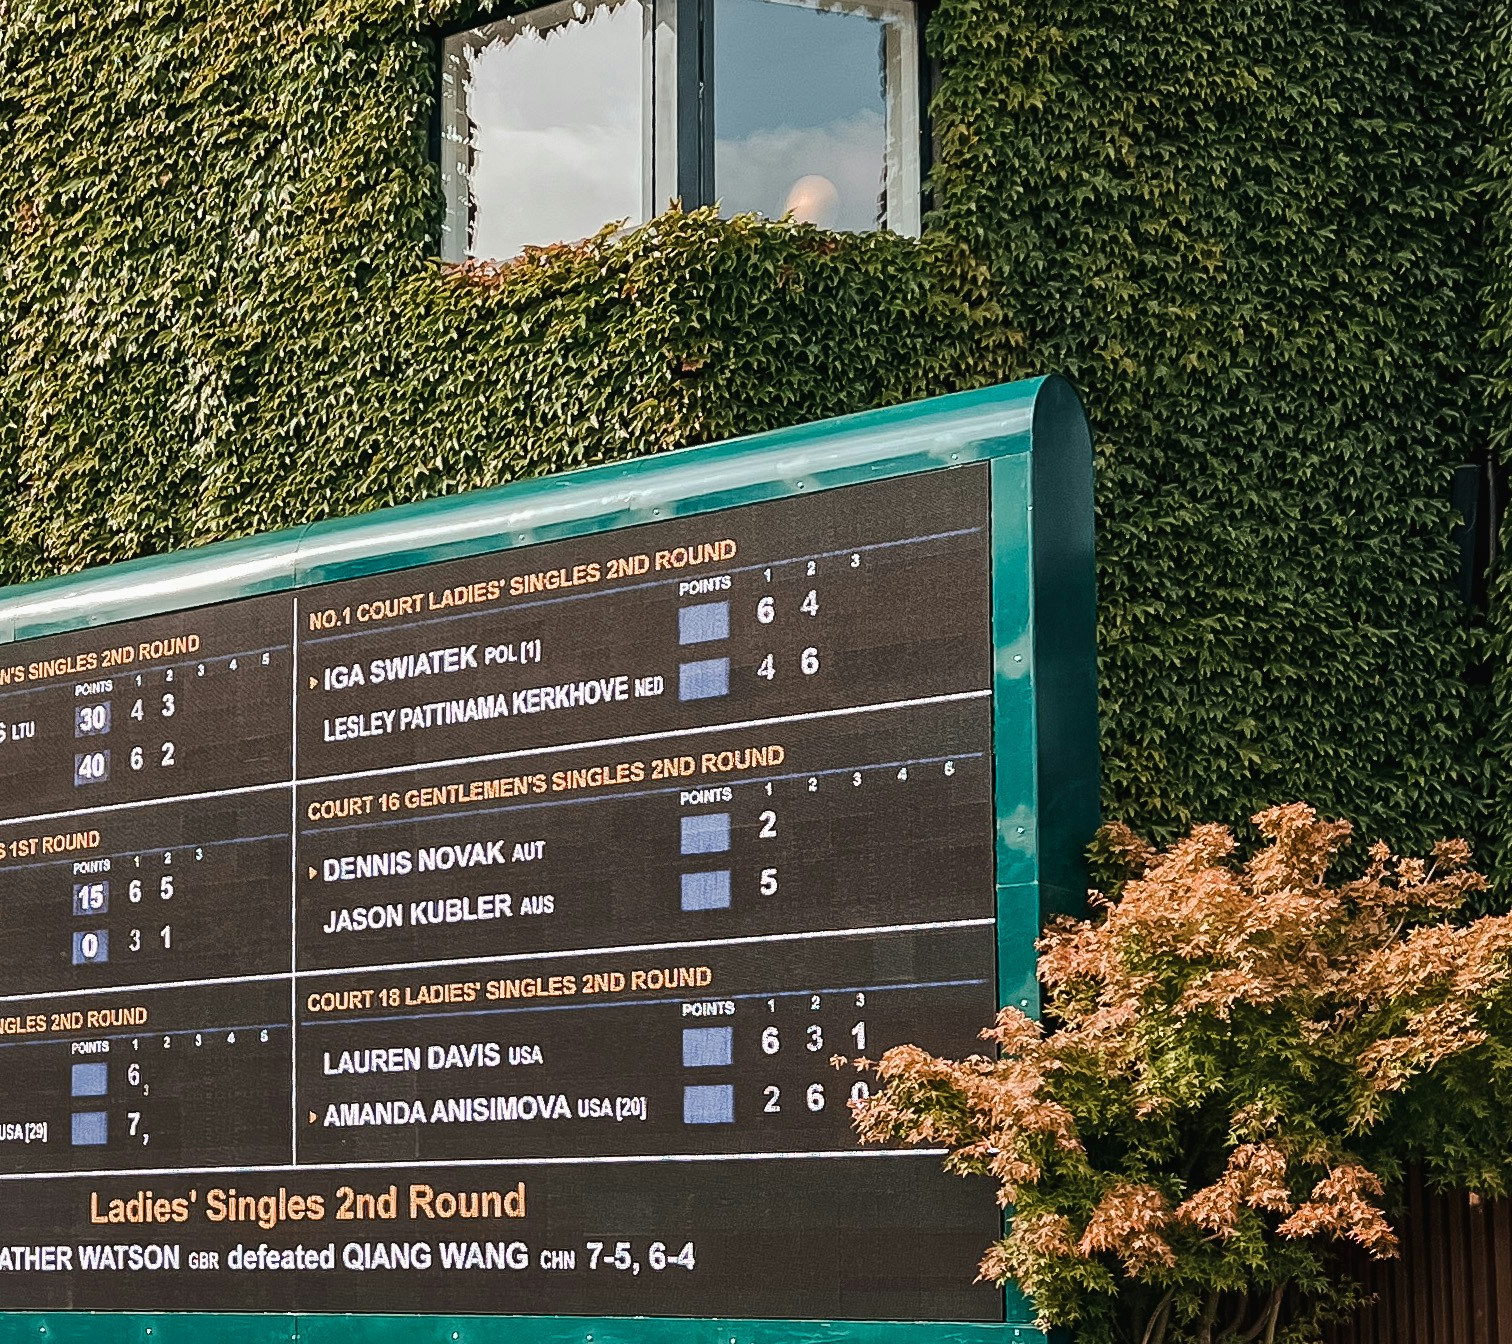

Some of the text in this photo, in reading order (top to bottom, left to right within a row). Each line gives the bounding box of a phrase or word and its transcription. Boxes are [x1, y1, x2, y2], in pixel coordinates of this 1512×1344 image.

[310, 539, 736, 630] NO.1 COURT LADIES' SINGLES 2ND ROUND
[679, 576, 731, 596] POINTS
[28, 653, 97, 679] SINGLES
[101, 646, 134, 667] 2ND
[139, 635, 199, 660] ROUND
[325, 645, 478, 690] IGA SWIATEK
[75, 680, 113, 696] POINTS
[80, 694, 174, 731] 30 4 3
[324, 676, 664, 741] LESLEY PATTINAMA KERKHOVE NED
[12, 721, 34, 740] LTU
[79, 742, 174, 778] 40 6 2
[308, 746, 784, 820] COURT 16 GENTLEMEN'S SINGLES 2ND ROUND
[681, 782, 735, 805] POINTS
[9, 839, 38, 857] 1ST
[43, 831, 100, 854] ROUND
[324, 840, 546, 881] DENNIS NOVAK AUT
[73, 859, 110, 875] POINTS
[79, 876, 173, 909] 15 6 5
[324, 894, 554, 933] JASON KUBLER AUS
[82, 925, 170, 957] 0 3 1
[308, 967, 711, 1011] COURT 18 LADIES' SINGLES 2ND ROUND
[51, 1012, 83, 1030] 2ND
[88, 1007, 147, 1027] ROUND
[680, 996, 737, 1016] POINTS
[72, 1041, 109, 1054] POINTS
[324, 1043, 543, 1075] LAUREN DAVIS USA
[324, 1095, 572, 1126] AMANDA ANISIMOVA
[91, 1182, 525, 1230] Ladies' Singles 2nd Round
[78, 1244, 179, 1270] WATSON
[189, 1252, 219, 1270] GBR
[228, 1243, 334, 1272] defeated
[343, 1242, 431, 1270] QIANG
[439, 1242, 528, 1269] WANG
[540, 1250, 575, 1269] CHN
[587, 1242, 639, 1275] 7-5,
[649, 1242, 695, 1270] 6-4
